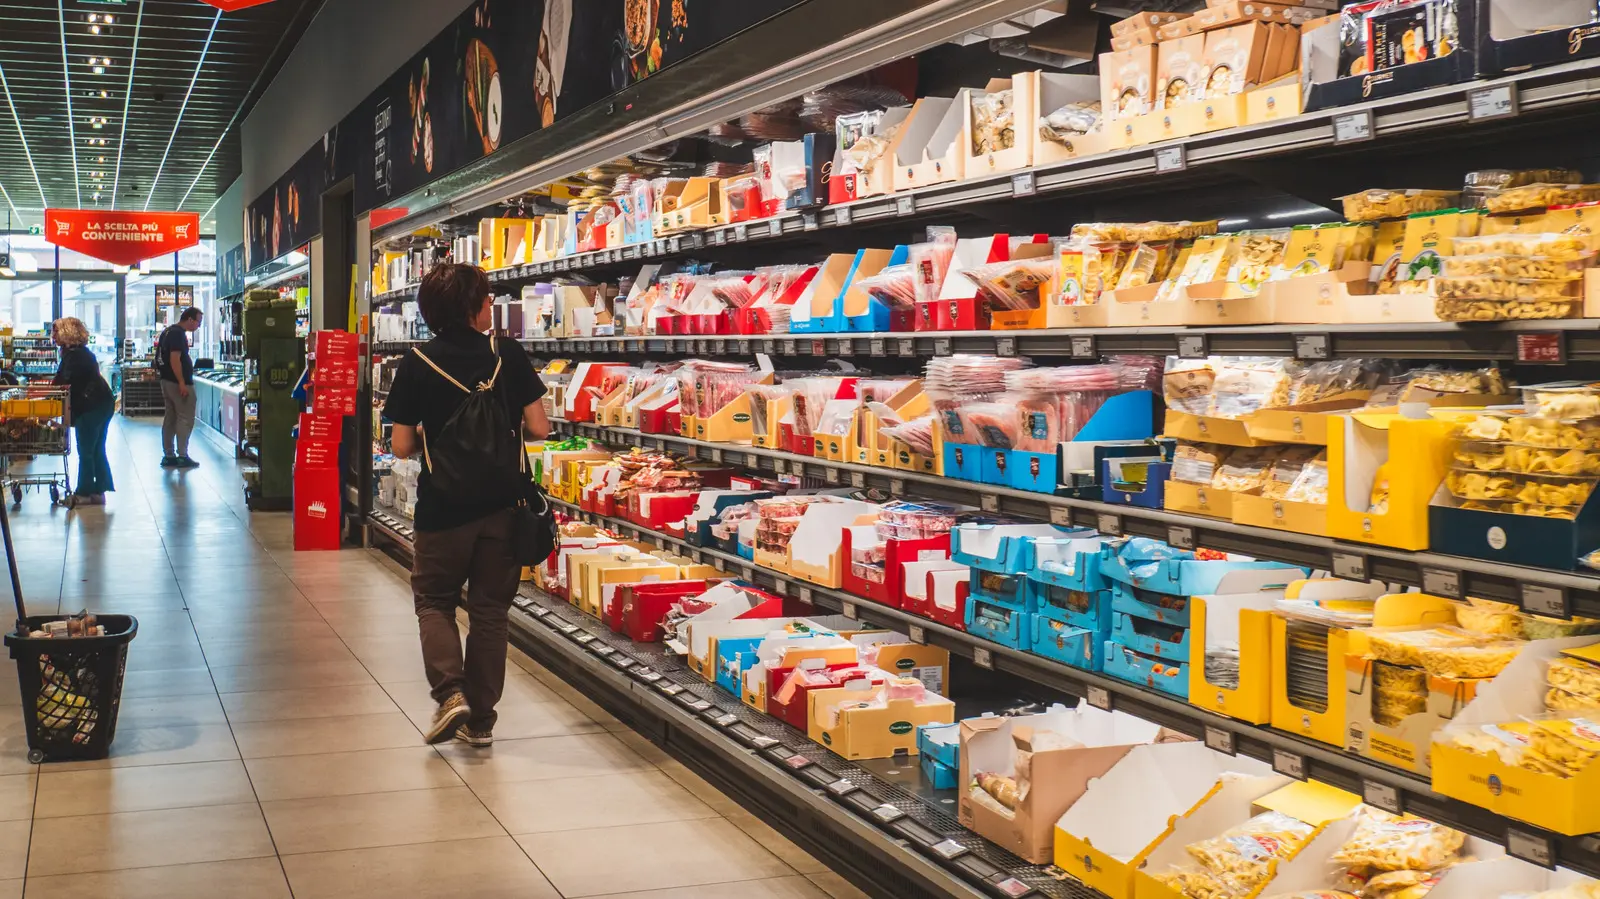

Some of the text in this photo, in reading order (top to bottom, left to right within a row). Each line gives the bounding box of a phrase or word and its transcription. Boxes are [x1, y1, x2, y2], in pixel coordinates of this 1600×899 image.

[87, 221, 158, 231] LA SCELTA PIÙ
[81, 231, 164, 242] CONVENIENTE
[270, 369, 289, 381] BIO
